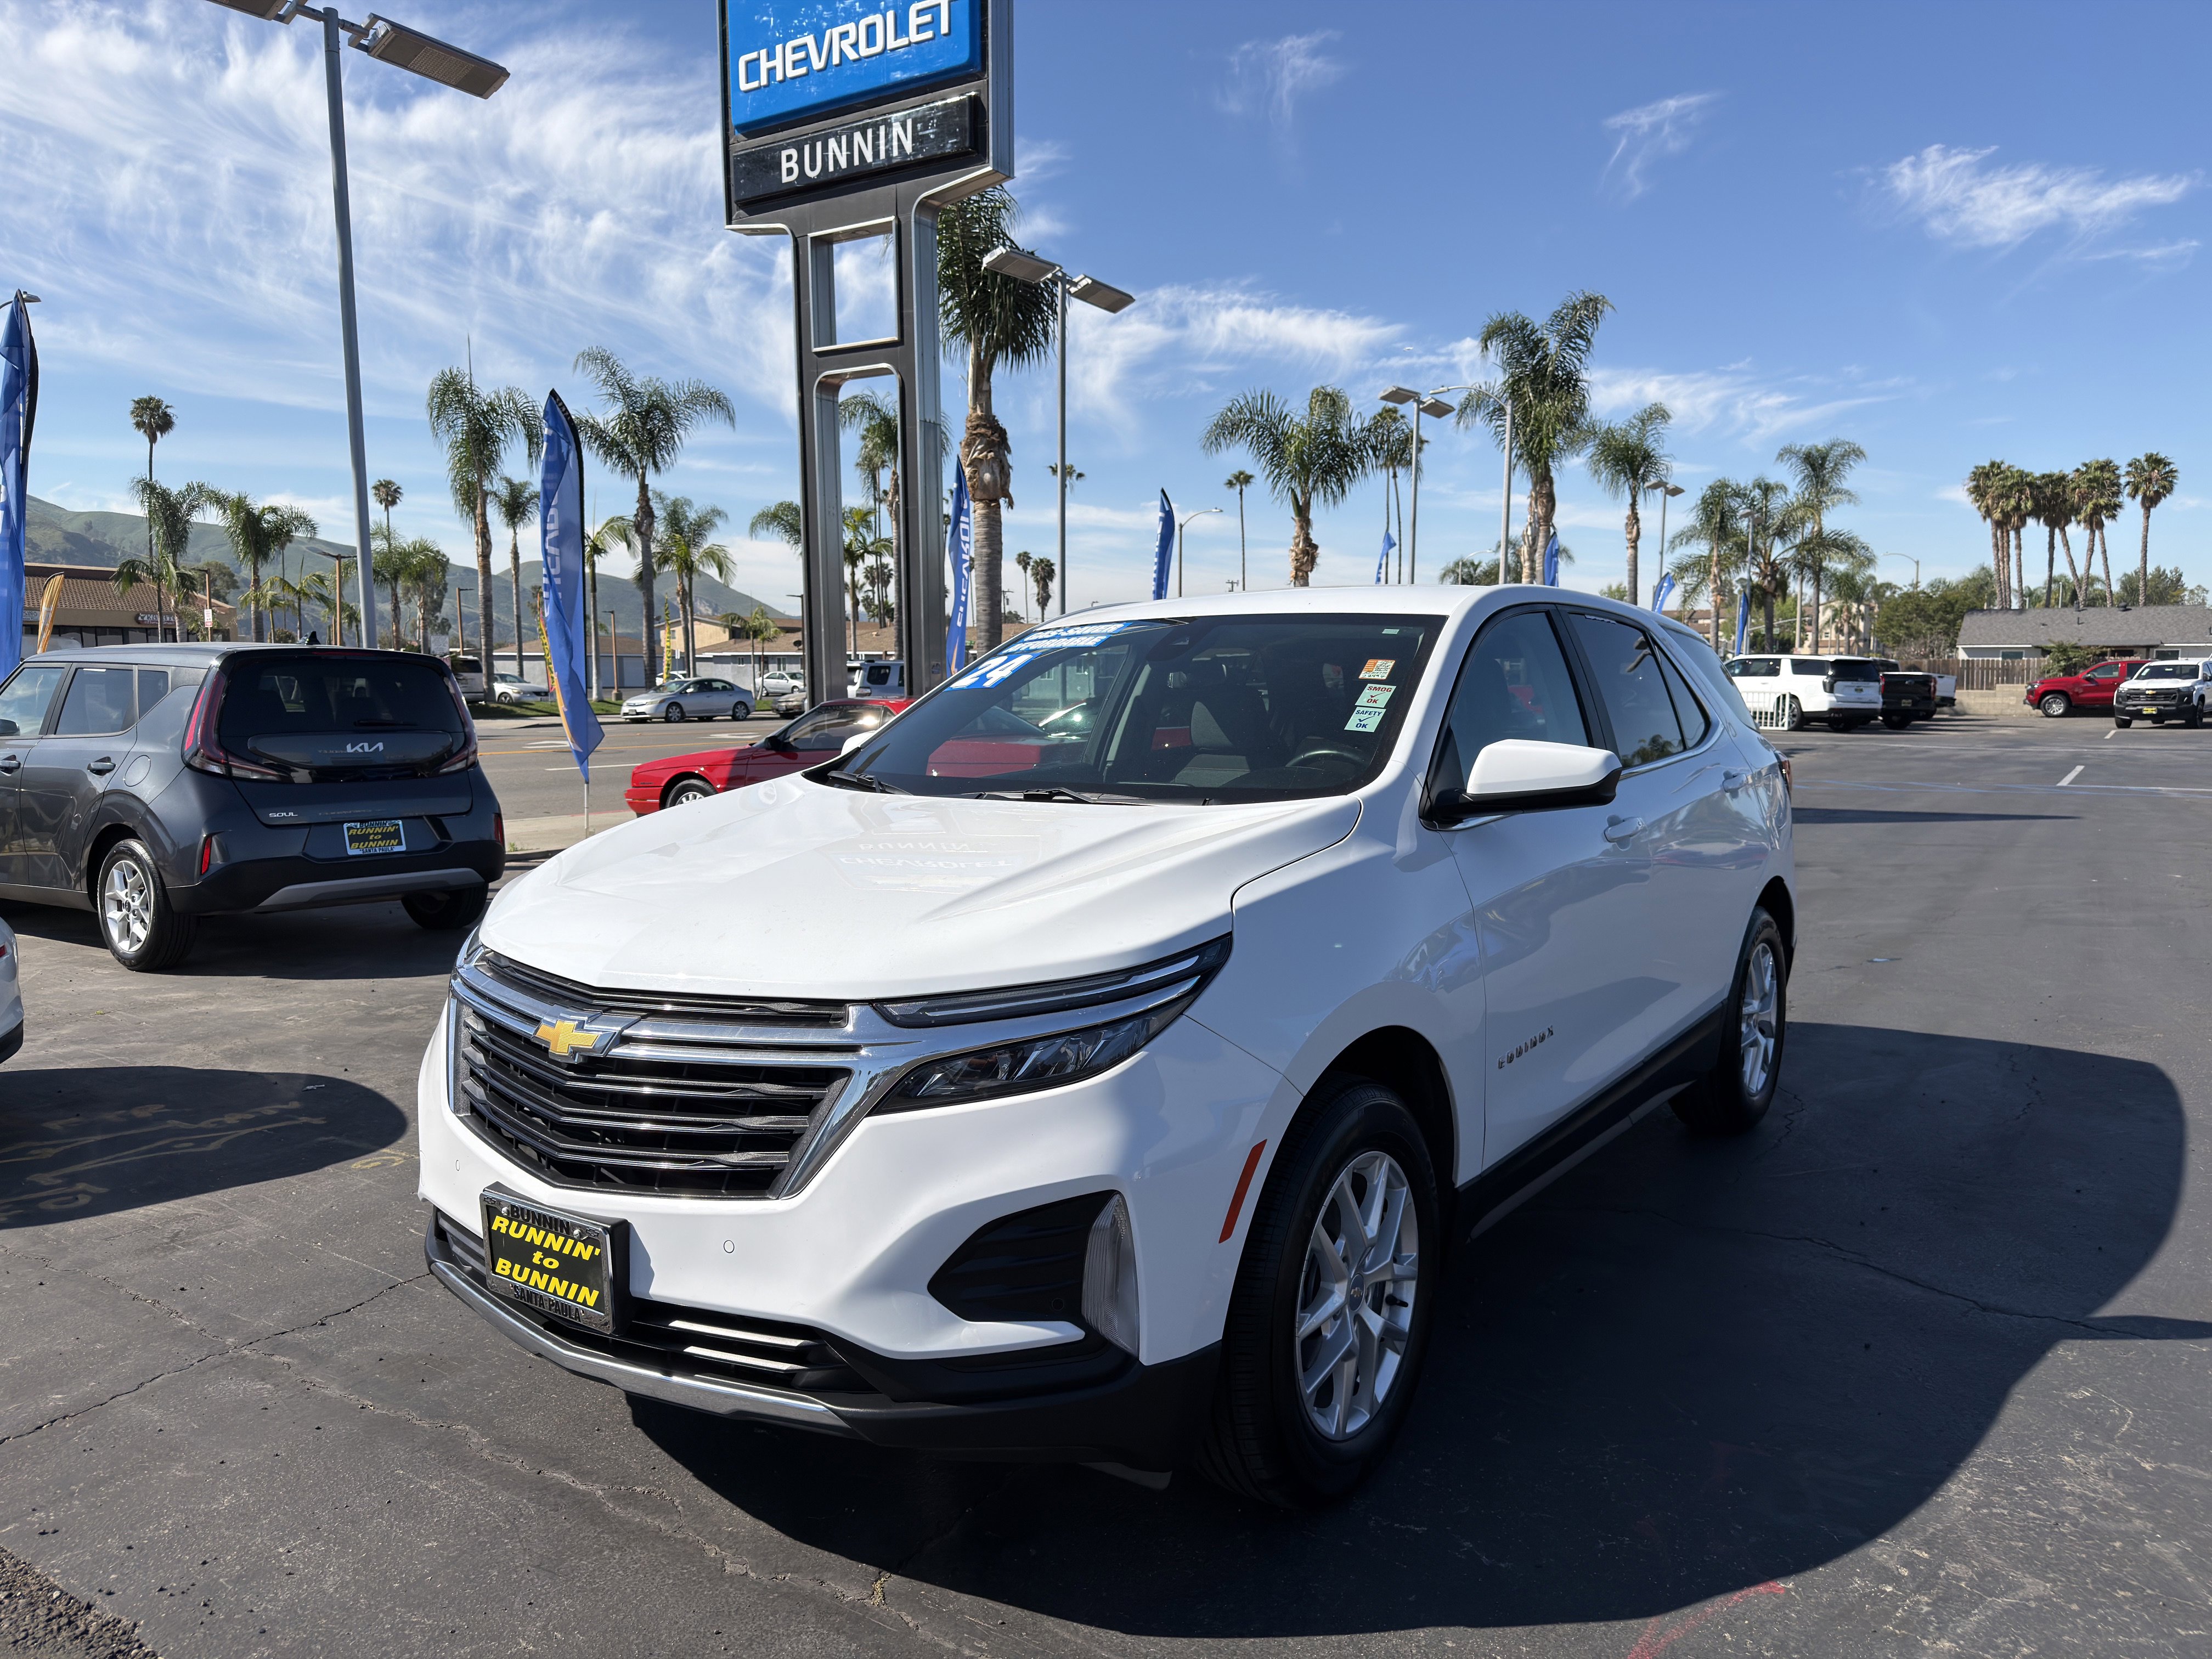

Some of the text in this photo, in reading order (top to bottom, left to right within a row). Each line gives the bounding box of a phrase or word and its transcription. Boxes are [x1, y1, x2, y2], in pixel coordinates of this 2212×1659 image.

[738, 0, 951, 92] CHEVROLET
[781, 118, 913, 184] BUNNIN
[1001, 636, 1107, 654] AFFORDABLE
[949, 654, 1033, 689] 24
[346, 742, 384, 753] KIA
[348, 826, 399, 835] RUNNIN'
[350, 839, 399, 849] BUNNIN
[1497, 1025, 1554, 1069] EQUINOX
[510, 1204, 571, 1235] BUNNIN
[492, 1215, 601, 1261] RUNNIN'
[532, 1251, 560, 1269] to
[495, 1257, 600, 1307] BUNNIN
[514, 1285, 582, 1322] SANTA PAULA
